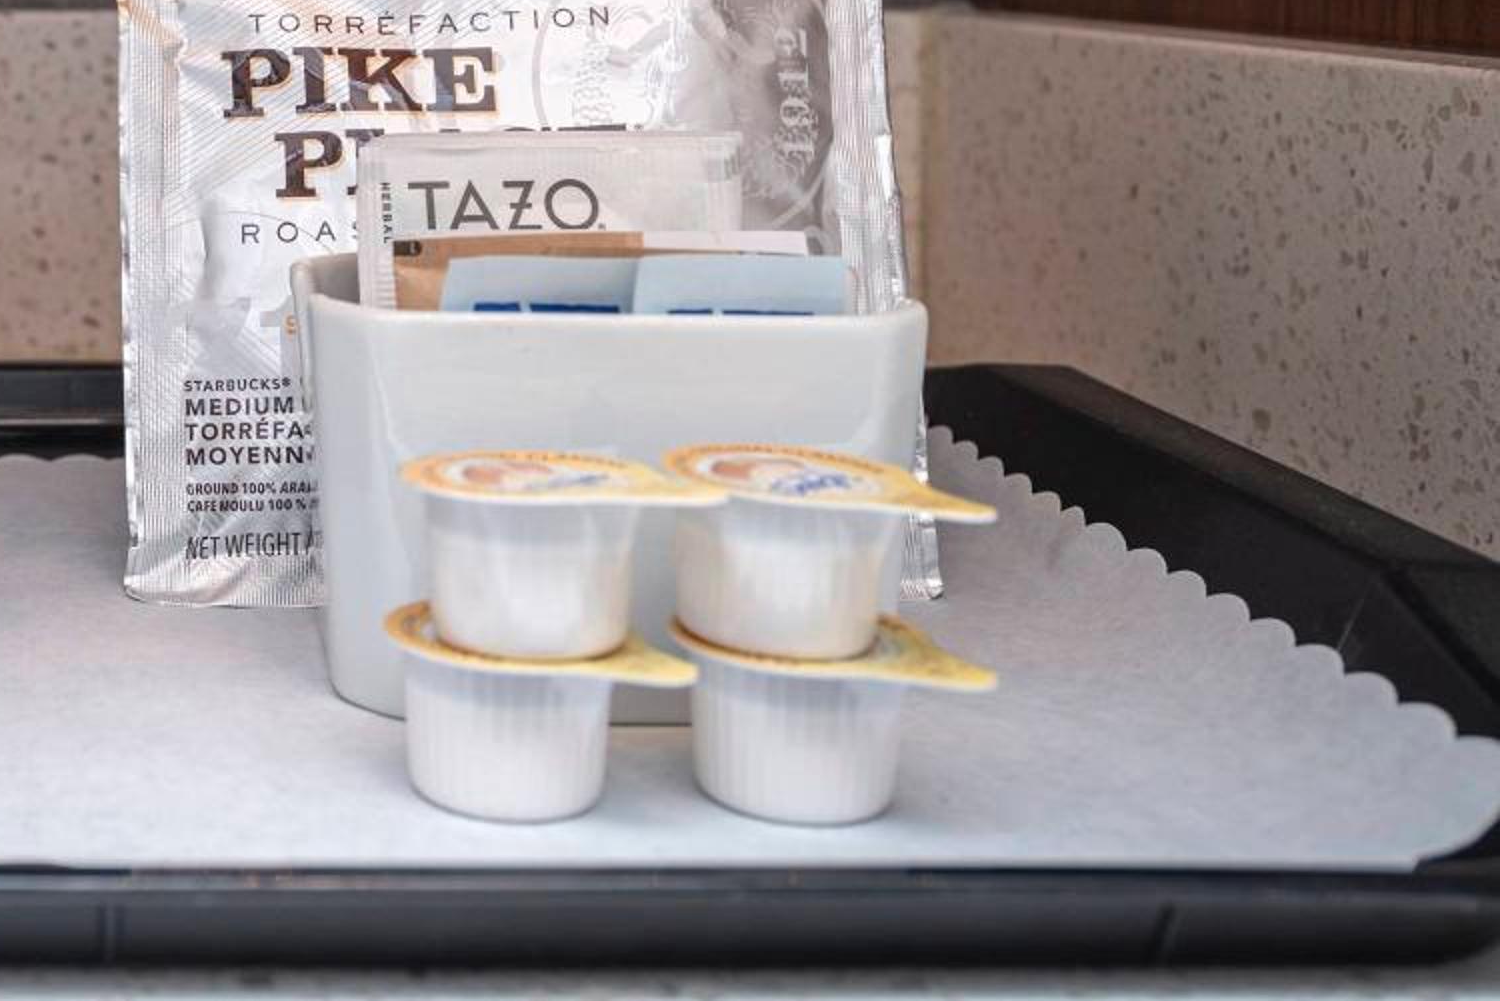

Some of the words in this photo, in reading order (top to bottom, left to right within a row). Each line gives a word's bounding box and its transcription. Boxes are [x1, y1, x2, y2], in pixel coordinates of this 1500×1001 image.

[248, 5, 611, 35] TORRÉFACTION
[220, 45, 499, 119] PIKE
[185, 395, 294, 416] MEDIUM
[185, 417, 304, 441] TORRÉFA
[186, 445, 304, 466] MOYENN
[186, 482, 239, 496] GROUND
[185, 535, 221, 561] NET
